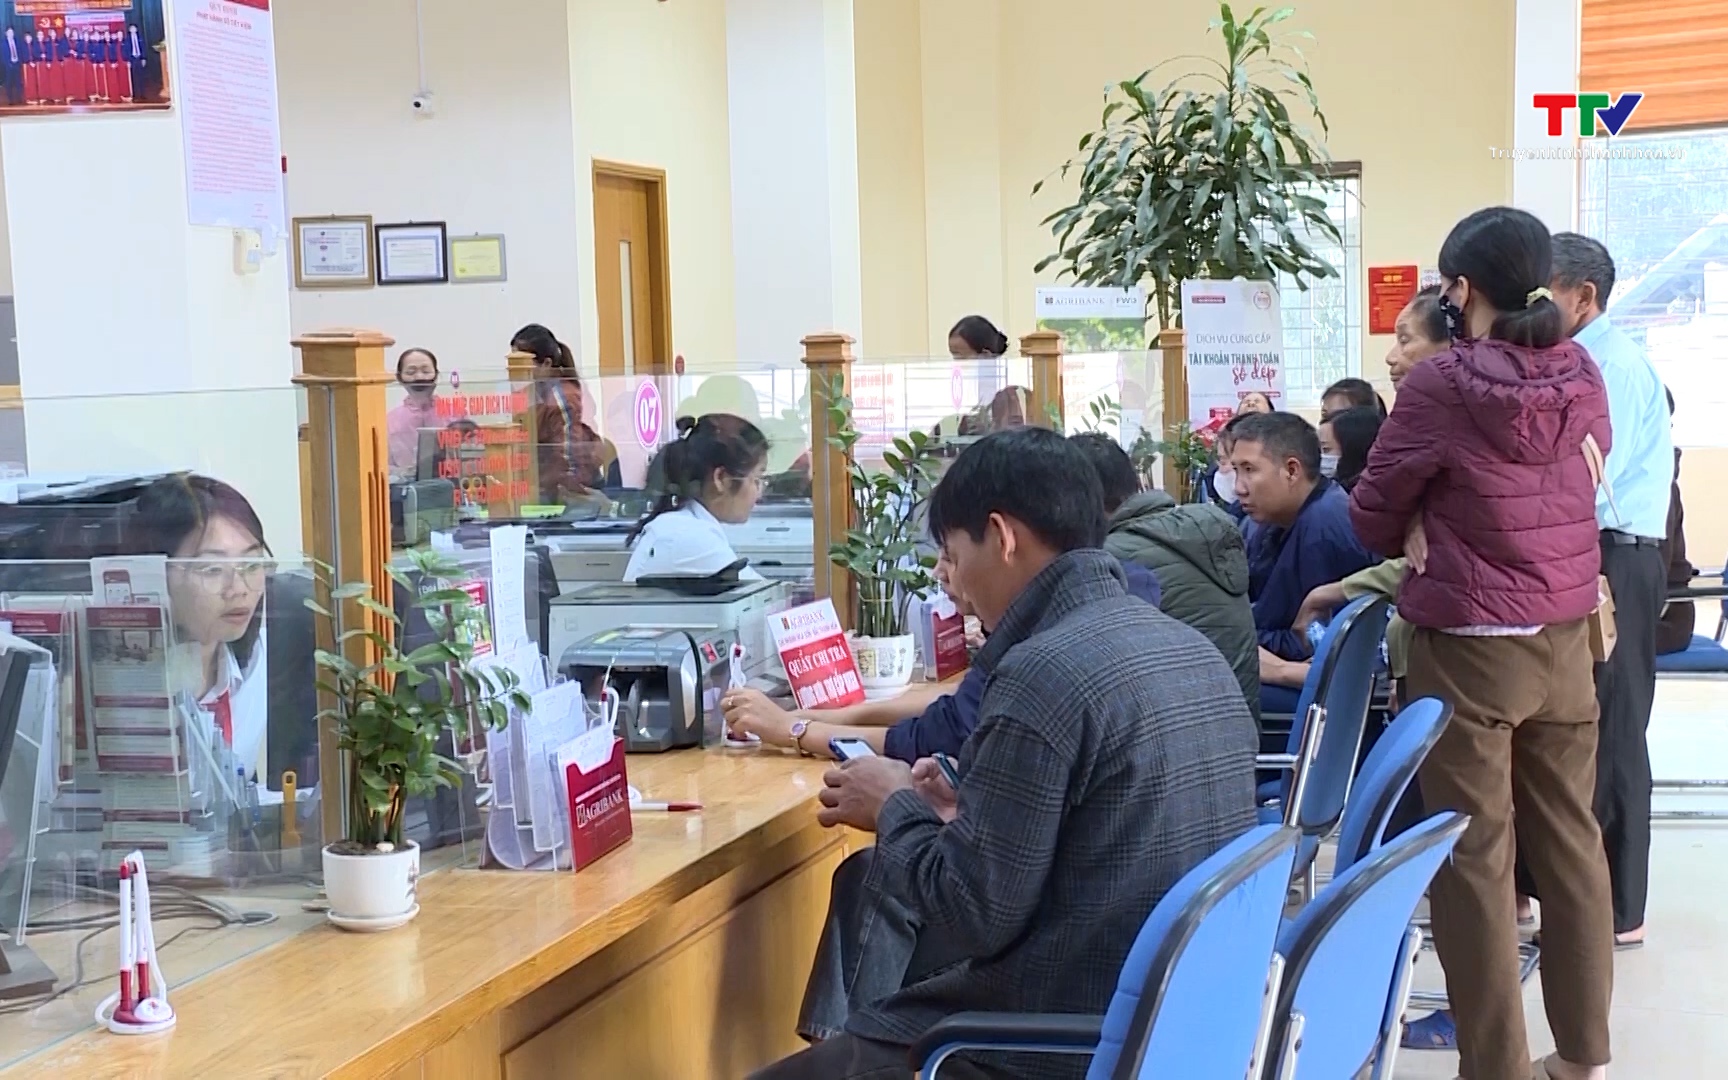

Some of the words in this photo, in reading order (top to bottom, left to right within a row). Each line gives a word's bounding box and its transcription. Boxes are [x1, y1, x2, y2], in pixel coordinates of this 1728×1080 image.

[1055, 297, 1105, 305] AGRIBANK
[1189, 352, 1202, 365] TÀI
[1204, 350, 1230, 365] KHOẢN
[1231, 353, 1258, 365] THANH
[1259, 352, 1279, 364] TOÁN
[640, 397, 657, 433] 07
[812, 648, 831, 672] CHI
[827, 639, 847, 662] TRẢ
[587, 788, 624, 820] AGRIBANK
